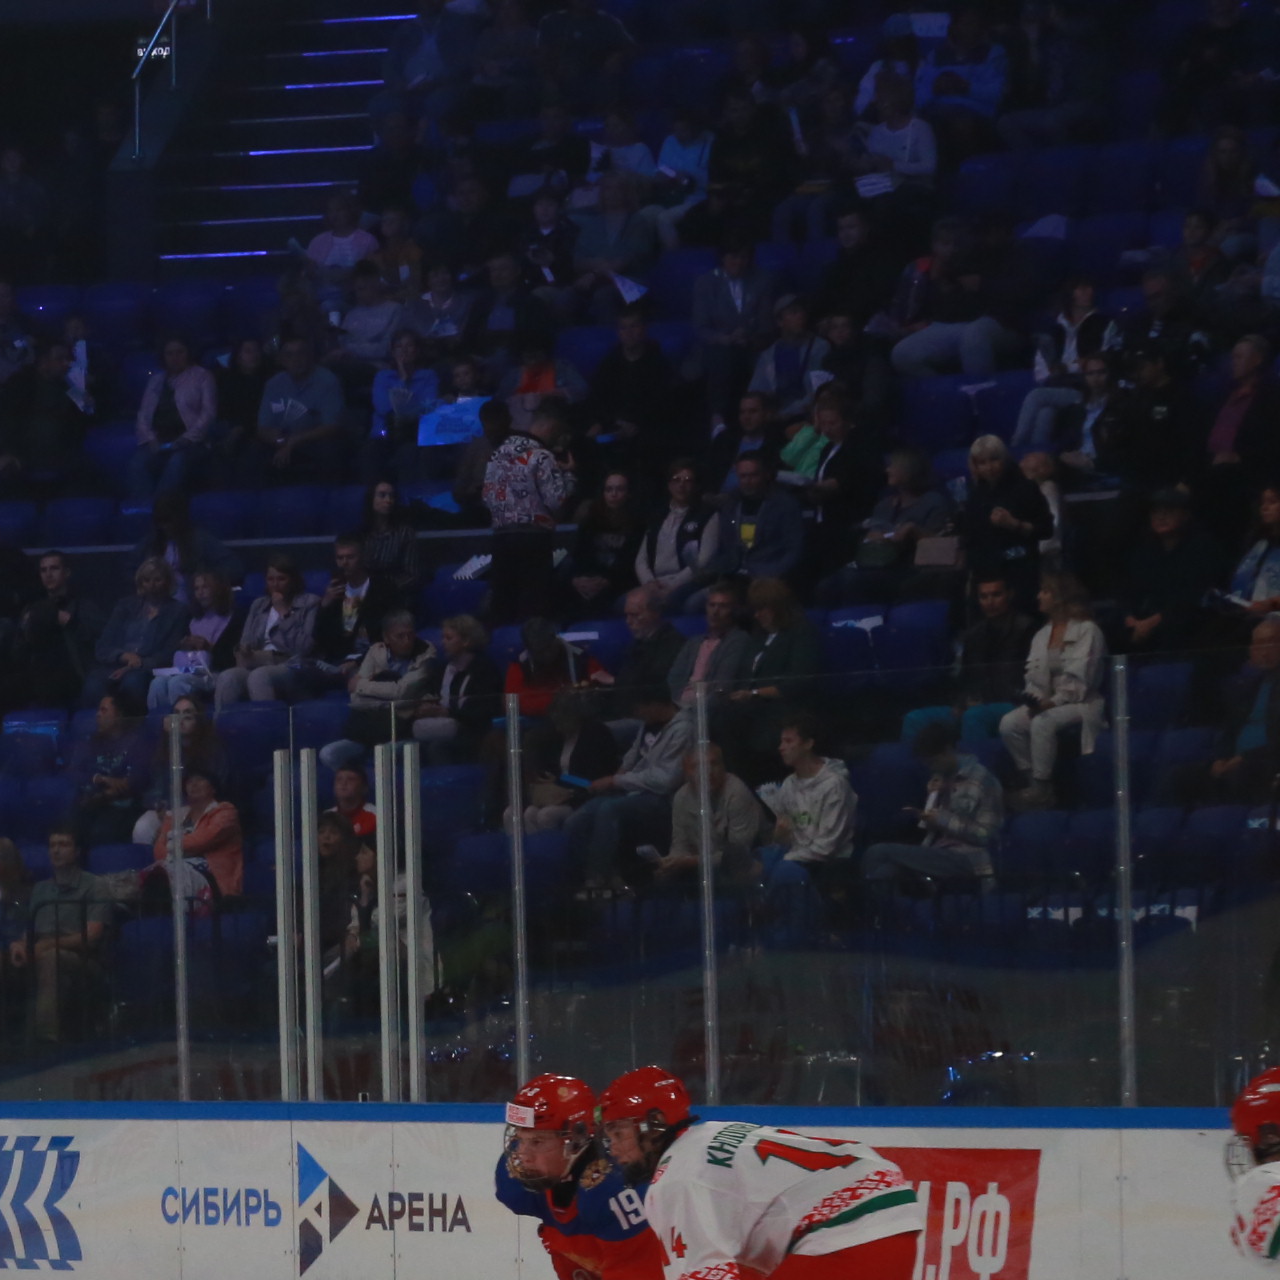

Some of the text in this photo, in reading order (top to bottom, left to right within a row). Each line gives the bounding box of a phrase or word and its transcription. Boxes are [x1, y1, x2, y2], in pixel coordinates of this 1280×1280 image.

[161, 1186, 282, 1227] СИБИРЬ
[365, 1193, 472, 1233] АРЕНА
[608, 1188, 648, 1230] 19
